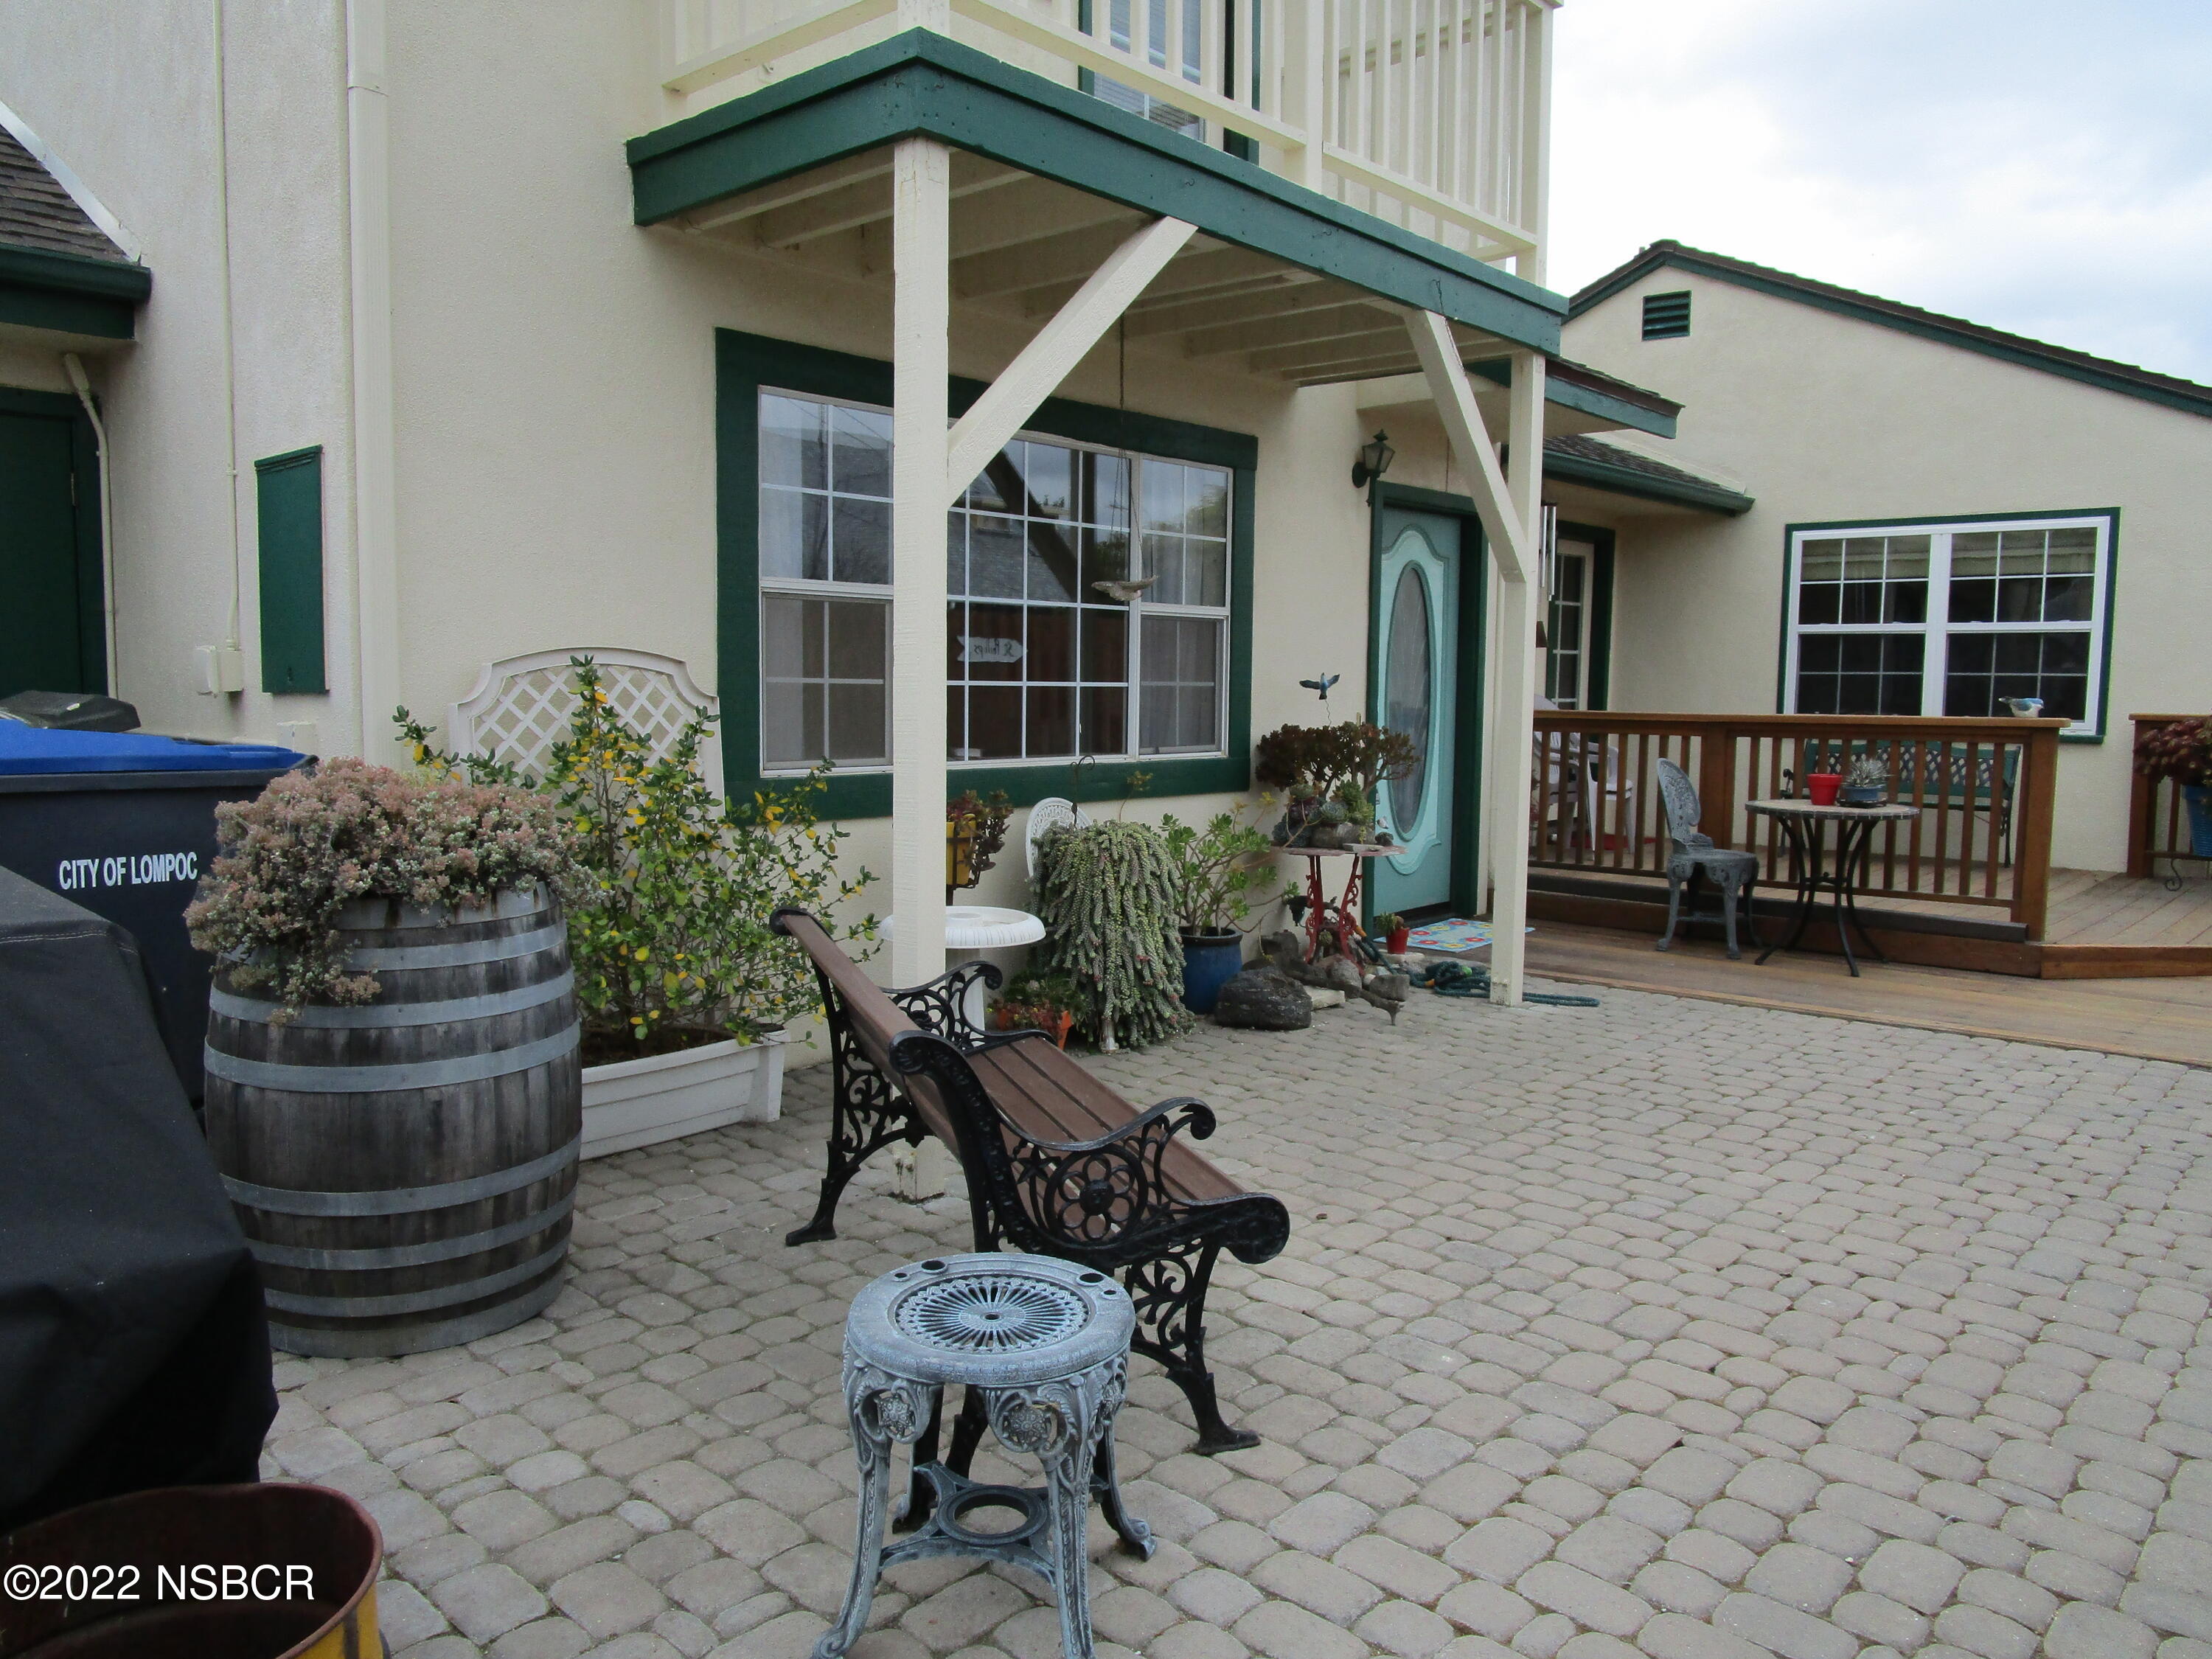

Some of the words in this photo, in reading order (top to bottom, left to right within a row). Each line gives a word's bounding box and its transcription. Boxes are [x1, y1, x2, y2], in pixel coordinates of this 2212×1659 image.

[59, 858, 100, 890] CITY
[103, 857, 127, 886] OF
[131, 852, 198, 884] LOMPOC
